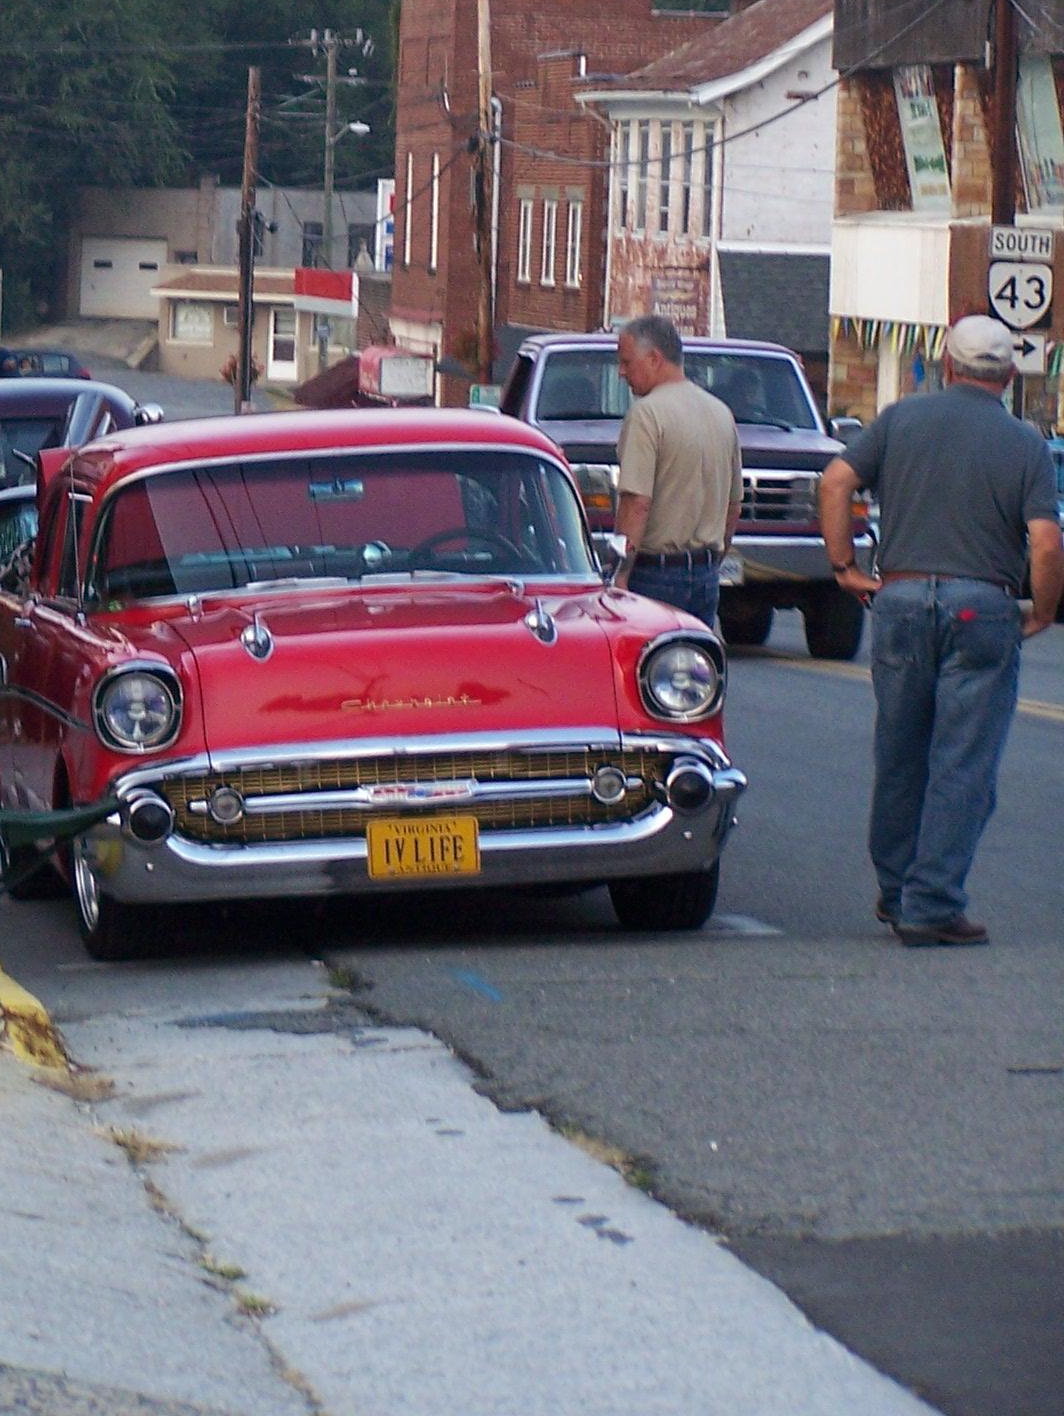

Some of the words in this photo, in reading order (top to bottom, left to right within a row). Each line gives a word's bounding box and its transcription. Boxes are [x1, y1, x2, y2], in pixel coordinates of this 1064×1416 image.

[994, 233, 1050, 254] SOUTH
[994, 275, 1045, 310] 43
[393, 822, 451, 834] VIRGINIA
